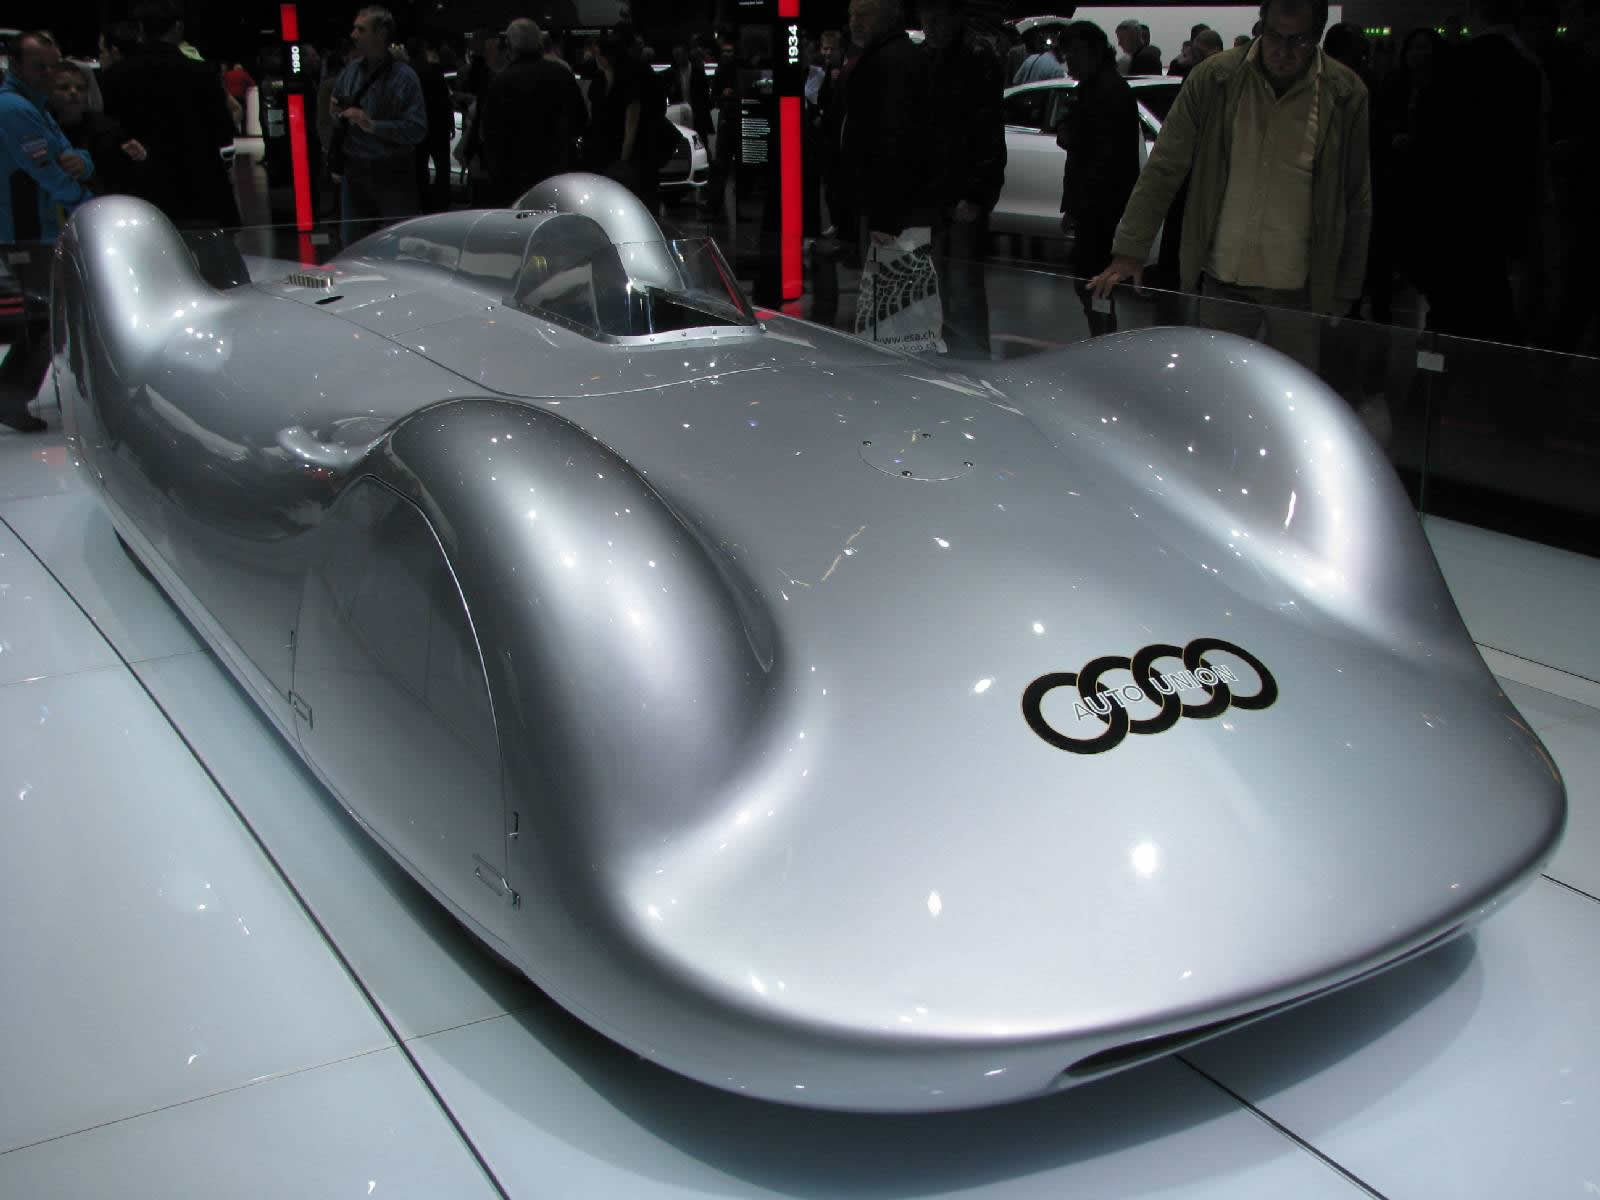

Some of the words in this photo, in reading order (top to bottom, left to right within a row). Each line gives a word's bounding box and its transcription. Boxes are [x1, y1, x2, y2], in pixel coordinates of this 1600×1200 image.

[788, 24, 799, 65] 1934
[1072, 684, 1145, 721] AUTO
[1149, 664, 1239, 695] UNION
